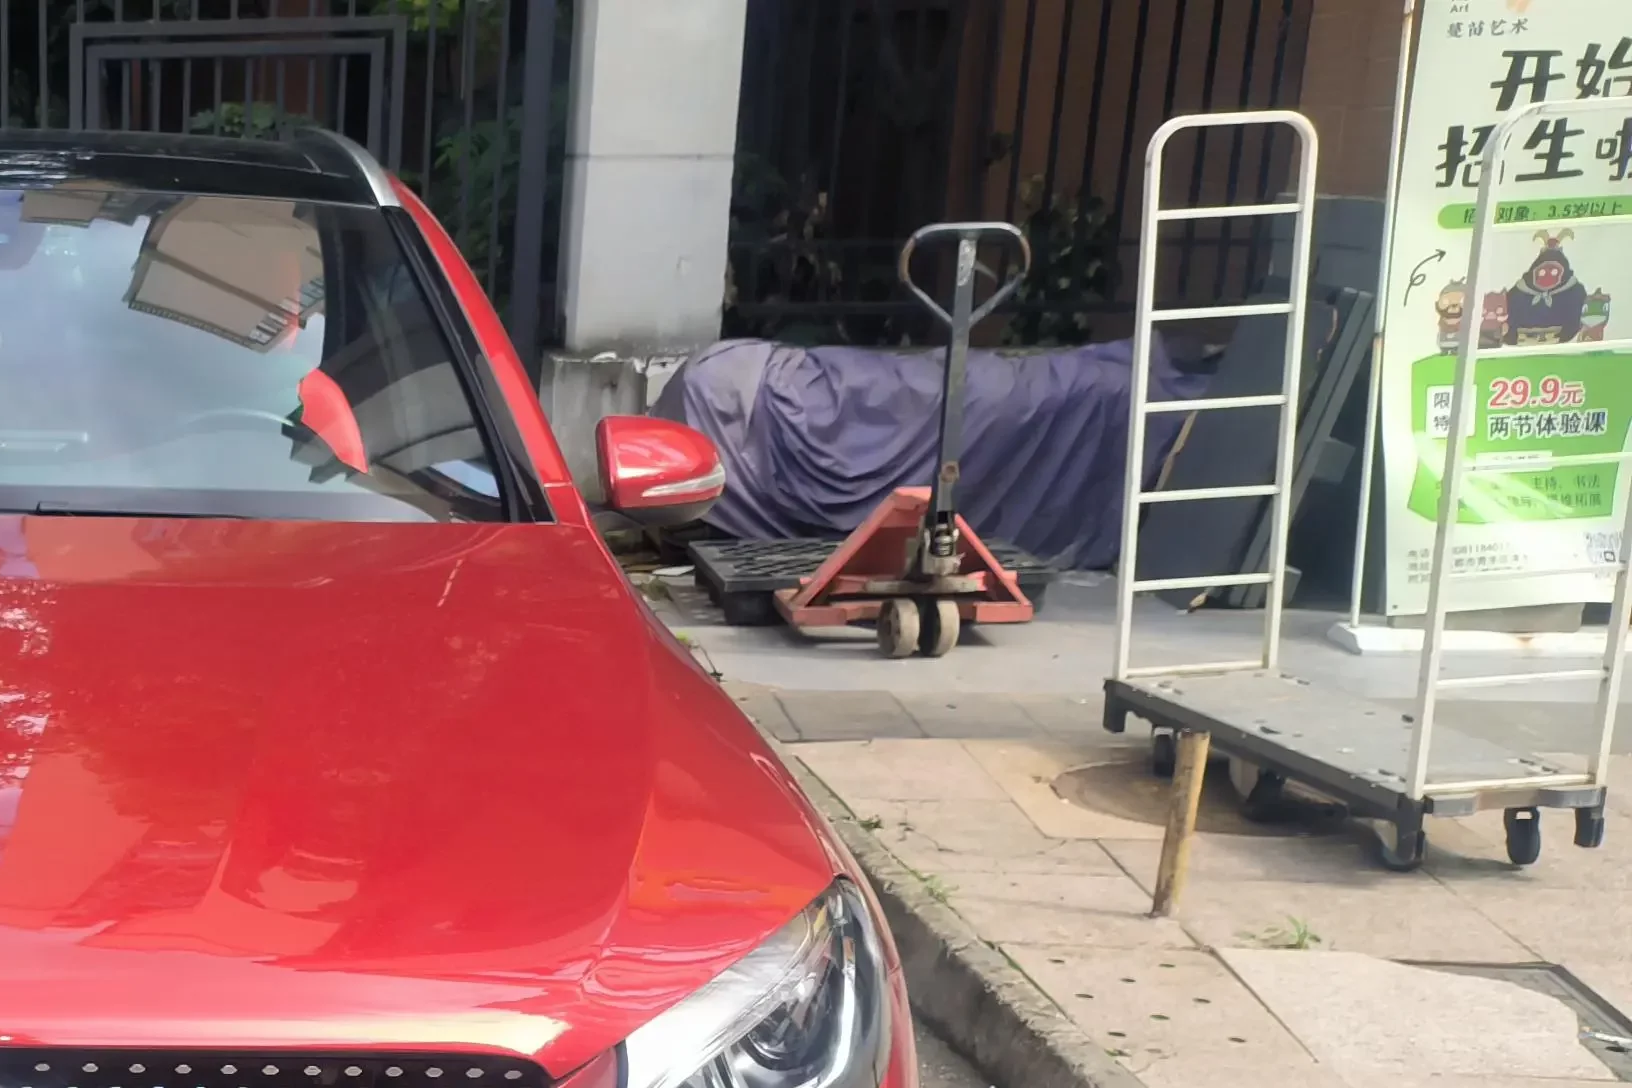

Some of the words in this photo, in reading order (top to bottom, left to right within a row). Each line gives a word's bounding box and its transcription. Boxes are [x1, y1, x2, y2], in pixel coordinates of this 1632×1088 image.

[1488, 376, 1585, 408] 29.9元
[1488, 411, 1606, 437] 两节体验课
